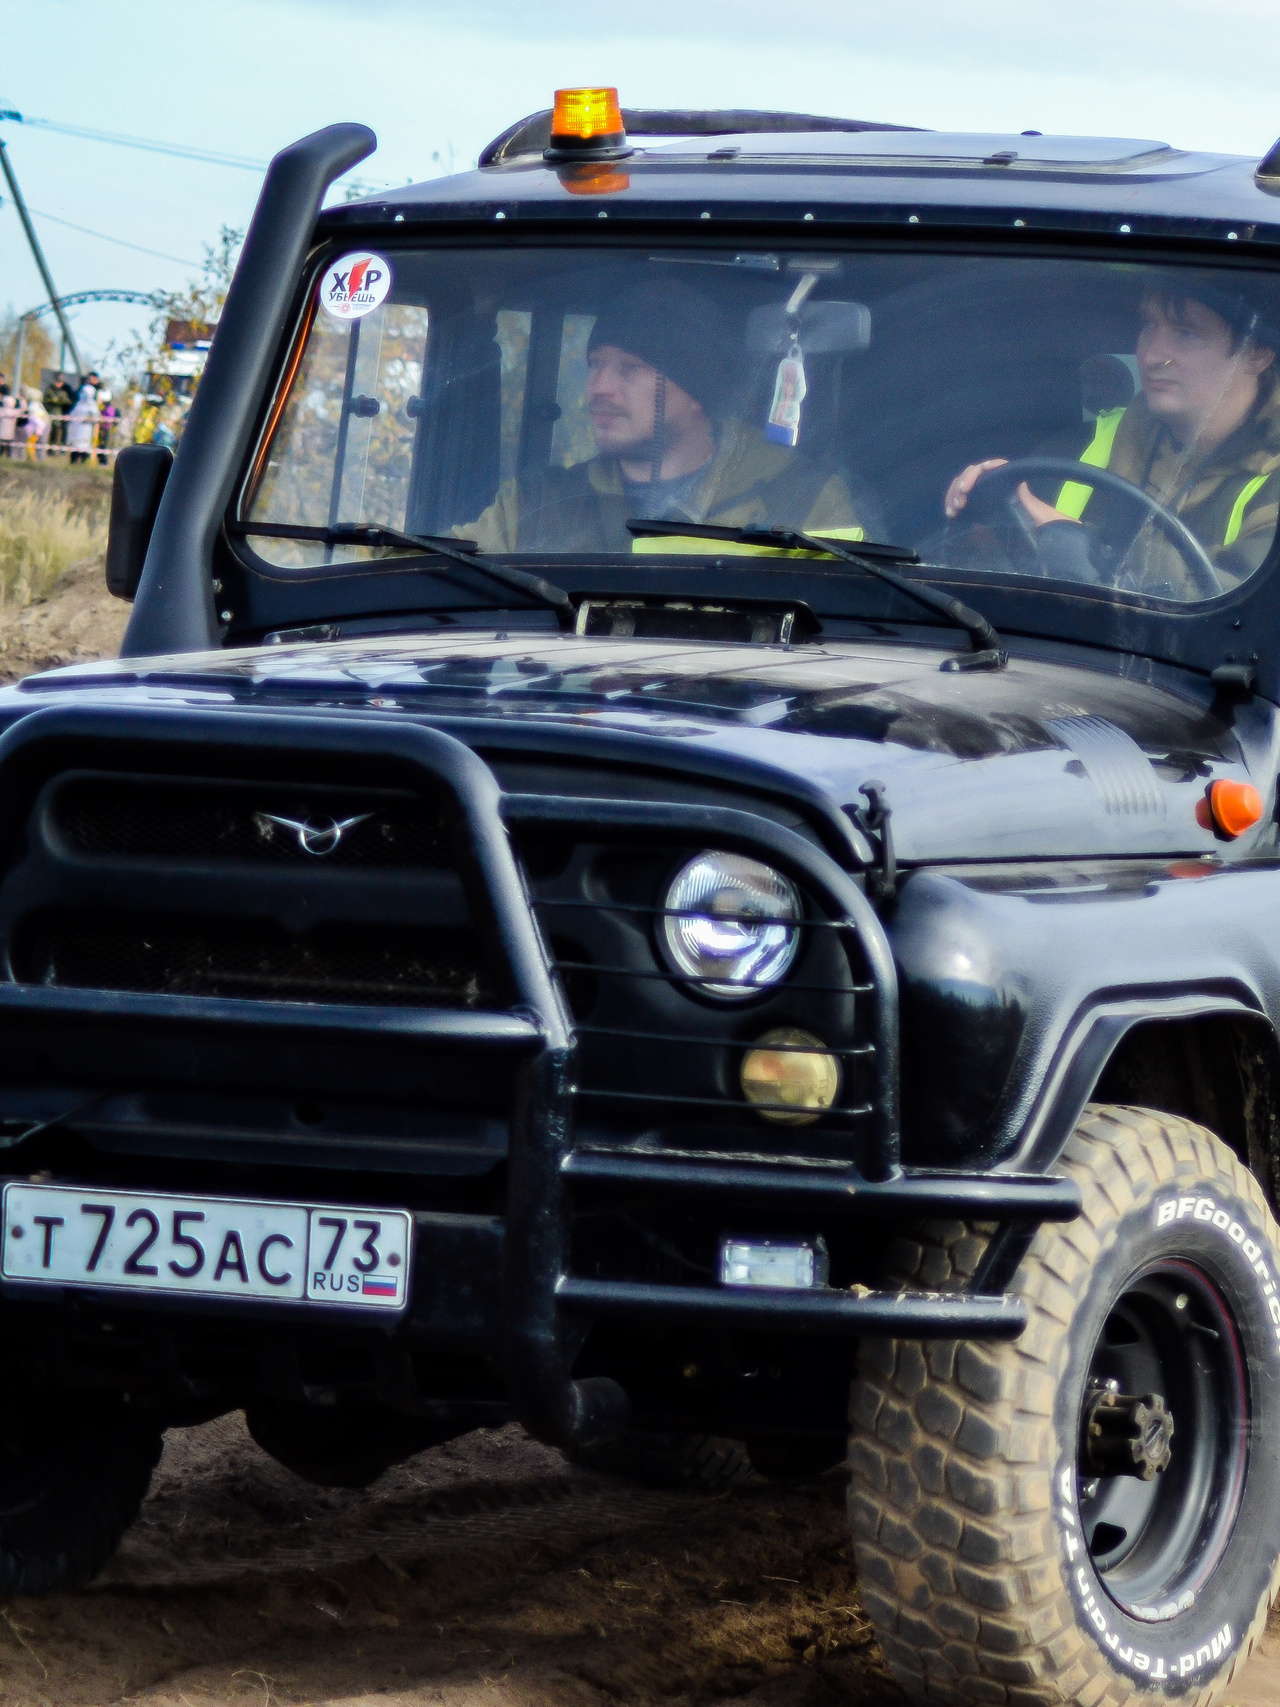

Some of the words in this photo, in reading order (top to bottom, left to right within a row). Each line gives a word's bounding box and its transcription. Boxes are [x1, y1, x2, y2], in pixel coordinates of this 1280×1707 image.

[330, 270, 382, 292] ХР
[319, 1217, 382, 1273] 73
[313, 1271, 360, 1294] RUS
